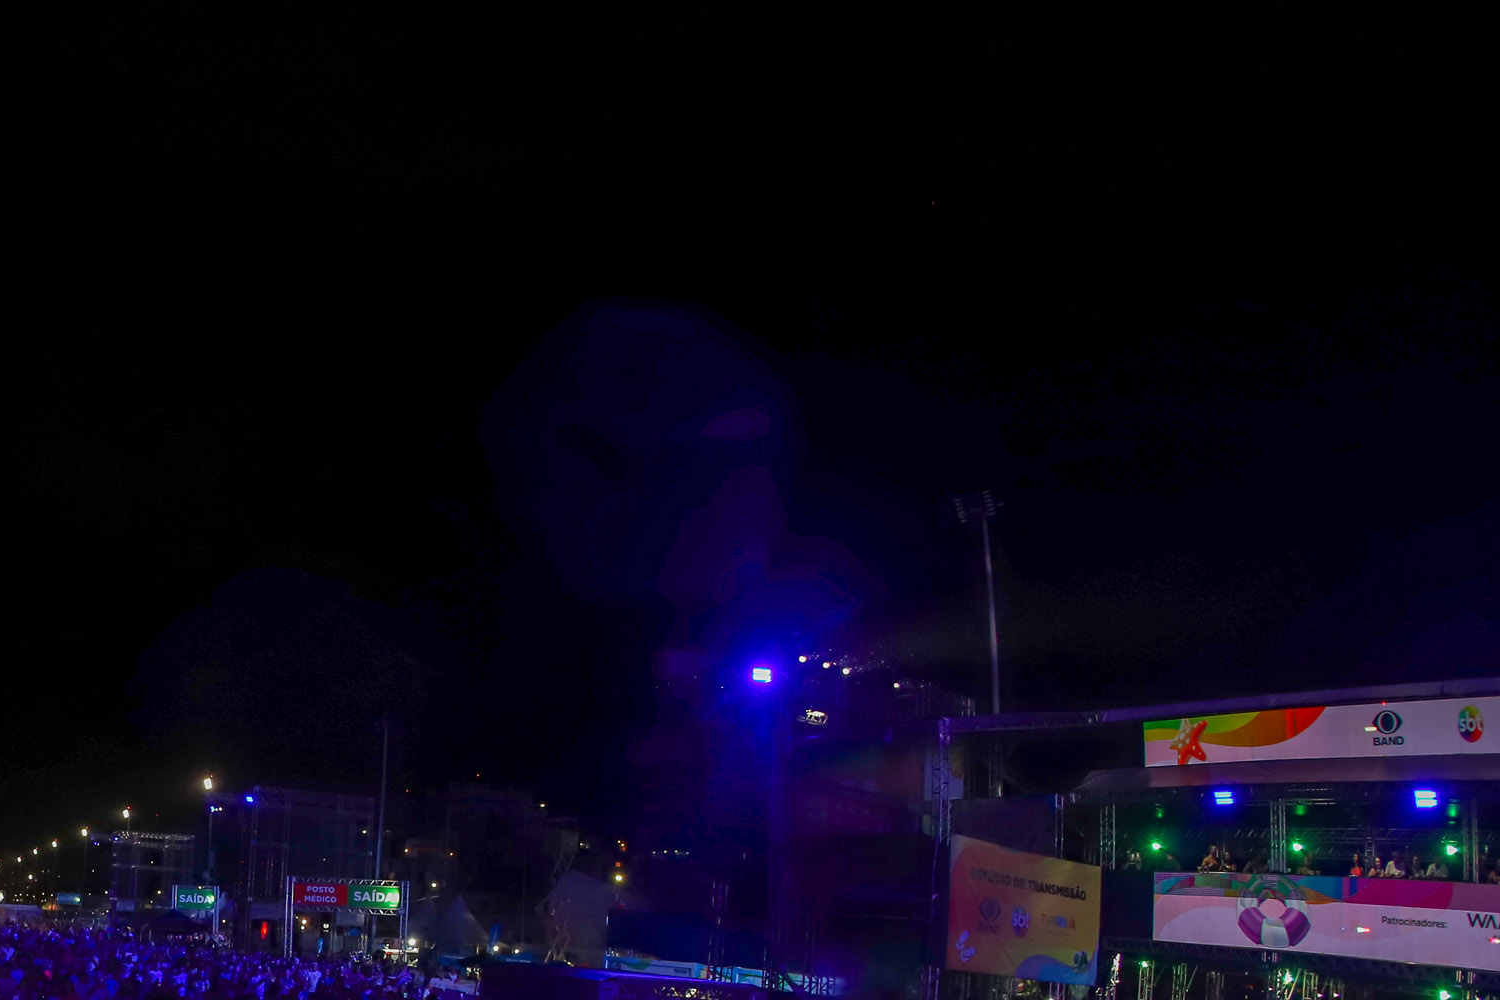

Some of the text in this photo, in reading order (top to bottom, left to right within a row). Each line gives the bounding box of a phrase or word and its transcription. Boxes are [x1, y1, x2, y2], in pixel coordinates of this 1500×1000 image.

[1459, 711, 1483, 732] sbt
[1373, 736, 1404, 746] BAND
[970, 868, 1087, 901] ESTÚDIO DE TRANSMISSÃO
[179, 893, 212, 904] SAÍDA
[304, 895, 337, 903] MÉDICO
[353, 890, 396, 903] SAÍDA
[1011, 907, 1031, 928] sbt
[1381, 916, 1448, 928] Patrocinadores:
[1466, 912, 1500, 929] WA
